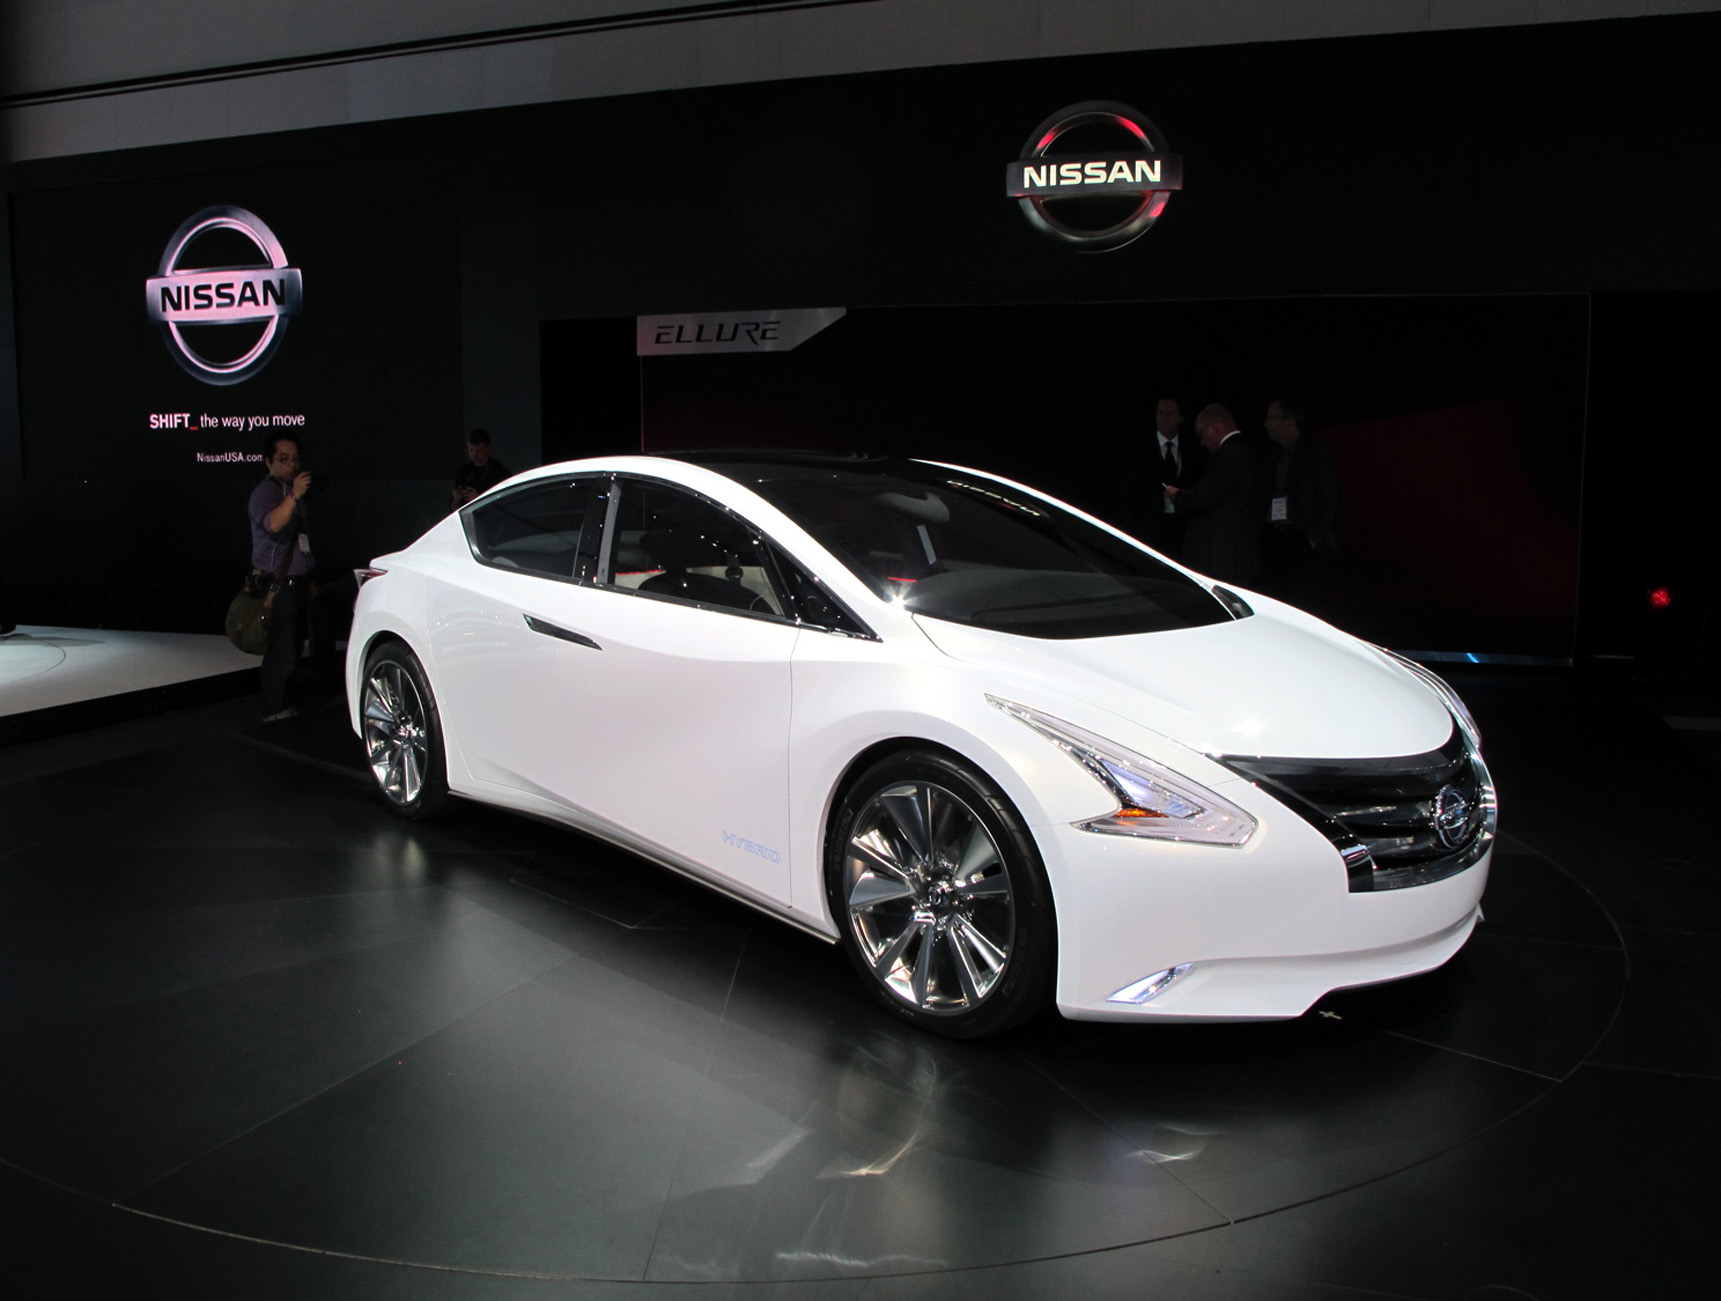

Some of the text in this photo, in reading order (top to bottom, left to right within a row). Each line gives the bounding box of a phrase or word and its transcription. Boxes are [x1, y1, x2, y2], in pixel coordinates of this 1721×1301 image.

[1023, 159, 1162, 189] NISSAN
[161, 278, 286, 313] NISSAN
[654, 320, 782, 346] ELLURE
[200, 412, 219, 428] the
[221, 415, 246, 432] way
[247, 415, 270, 432] you
[272, 414, 306, 427] move
[722, 829, 782, 864] HYBRID
